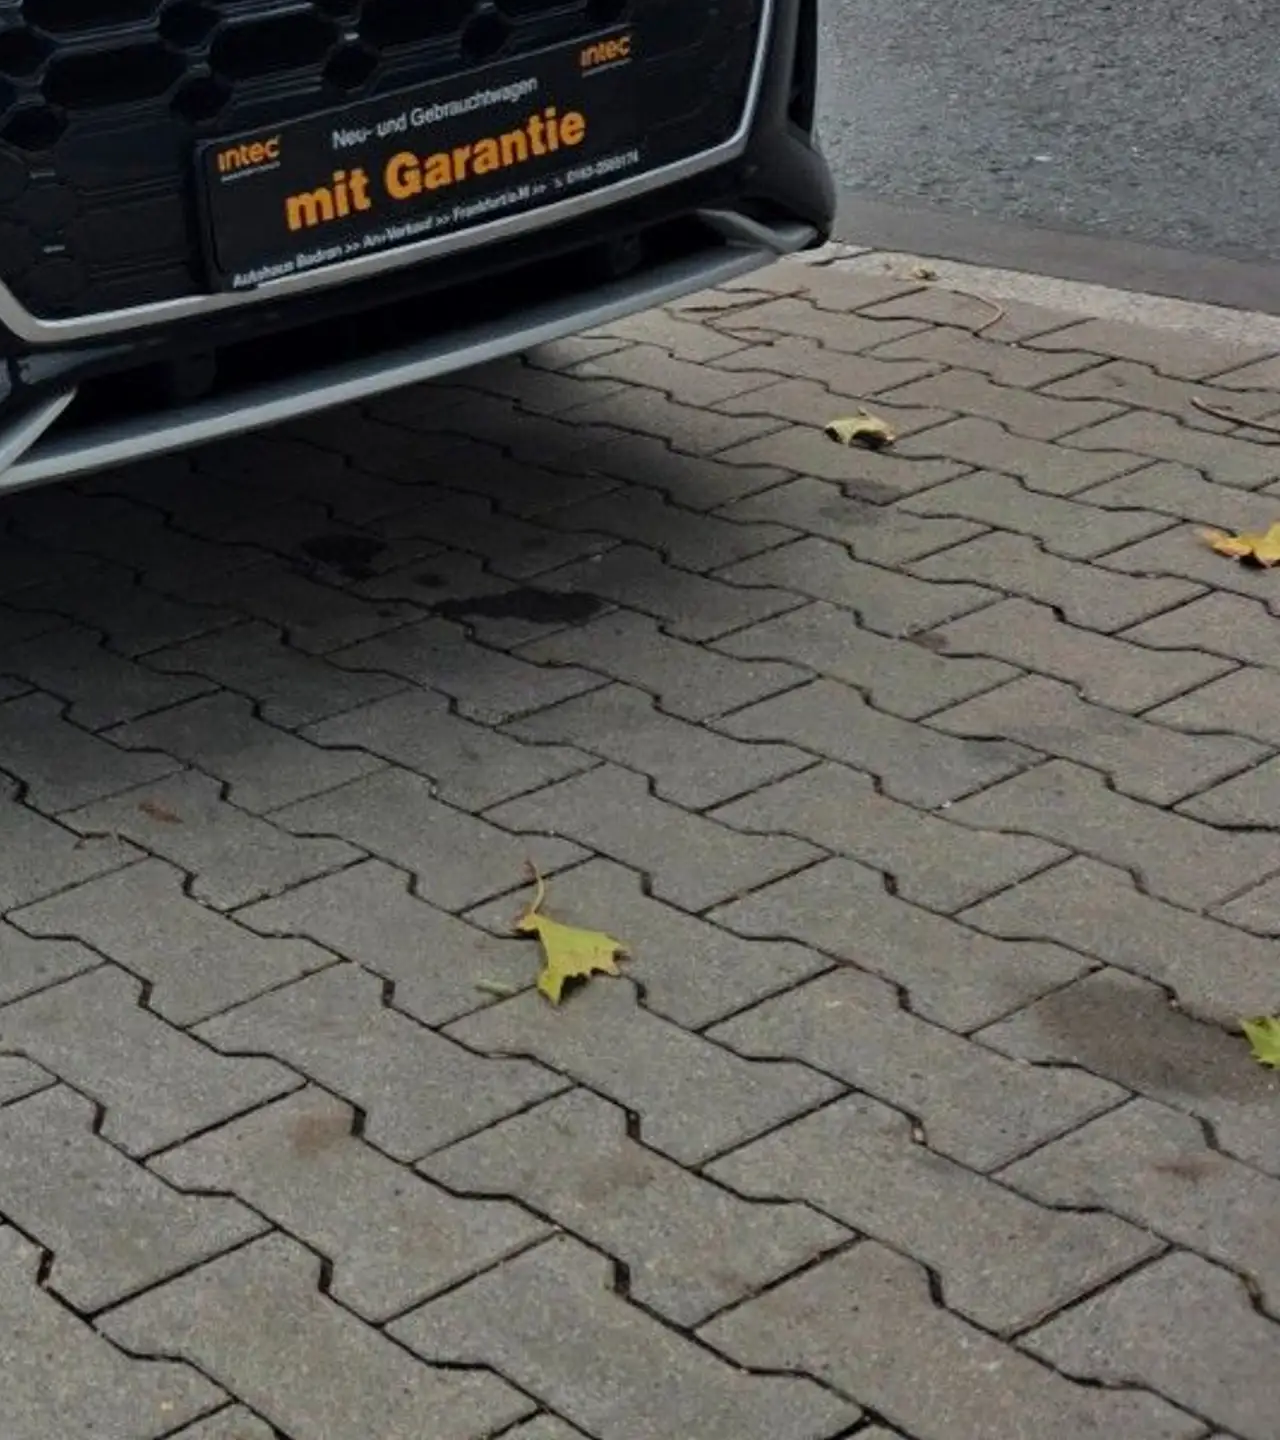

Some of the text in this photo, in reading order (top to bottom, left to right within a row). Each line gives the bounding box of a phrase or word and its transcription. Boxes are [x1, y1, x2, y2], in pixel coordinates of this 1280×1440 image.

[331, 77, 538, 150] Neu- und Gebrauchtwagen
[217, 135, 282, 172] intec
[285, 106, 587, 232] mit Garantie
